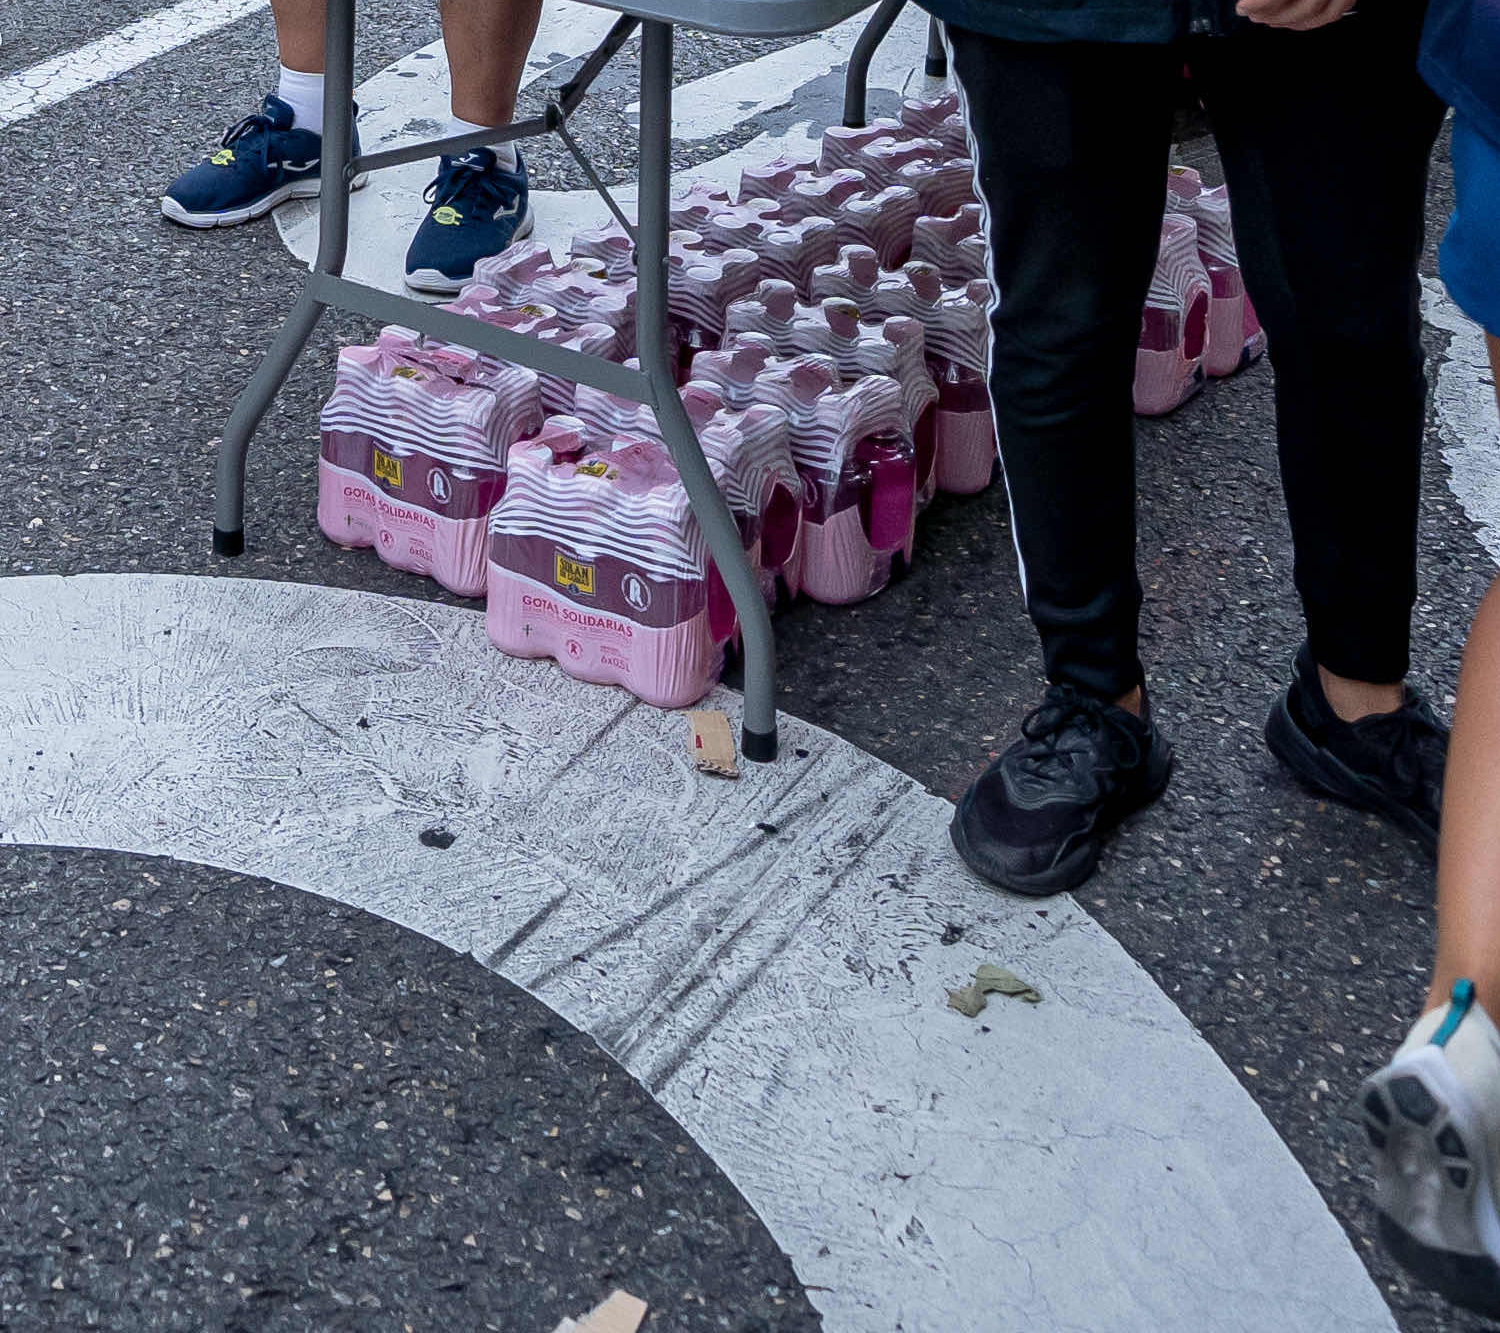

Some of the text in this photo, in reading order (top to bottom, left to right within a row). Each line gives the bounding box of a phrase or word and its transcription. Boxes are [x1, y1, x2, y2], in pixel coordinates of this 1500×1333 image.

[344, 487, 437, 530] GOTAS SOLIDARIAS
[523, 595, 633, 638] GOTAS SOLIDARIAS
